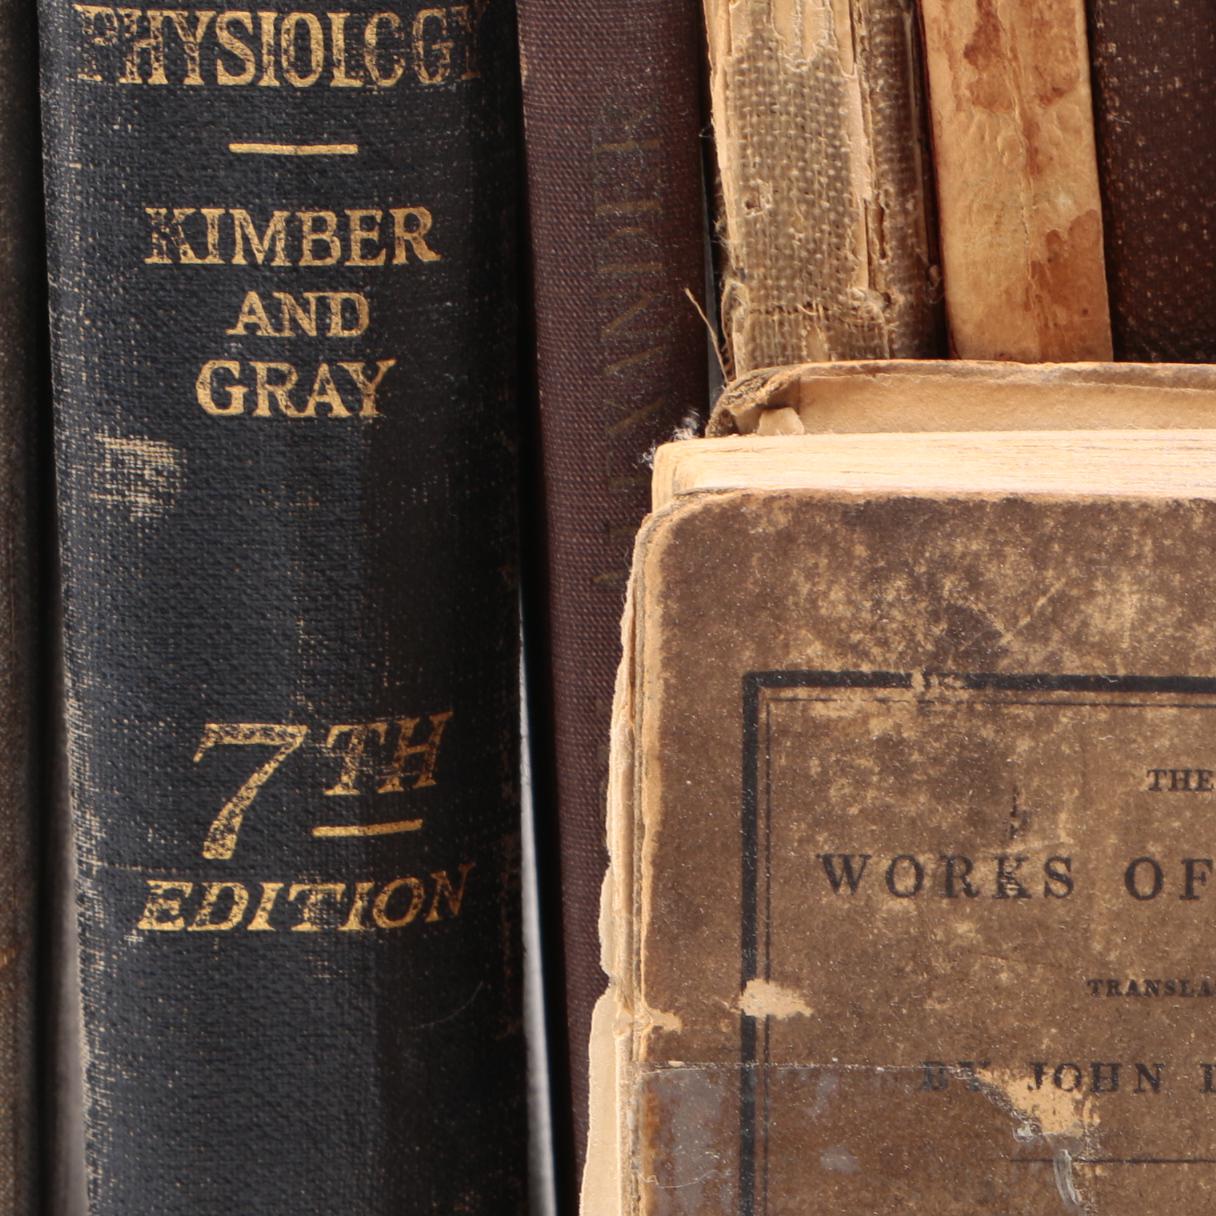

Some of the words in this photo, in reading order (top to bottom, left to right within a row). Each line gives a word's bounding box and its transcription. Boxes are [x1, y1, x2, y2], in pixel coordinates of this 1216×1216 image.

[144, 205, 442, 267] KIMBER
[226, 291, 371, 337] AND
[195, 358, 396, 418] GRAY
[1147, 768, 1214, 792] THE
[137, 863, 476, 932] EDITION
[817, 853, 1074, 899] WORKS
[1123, 855, 1214, 901] OF
[1027, 1060, 1166, 1094] JOHN
